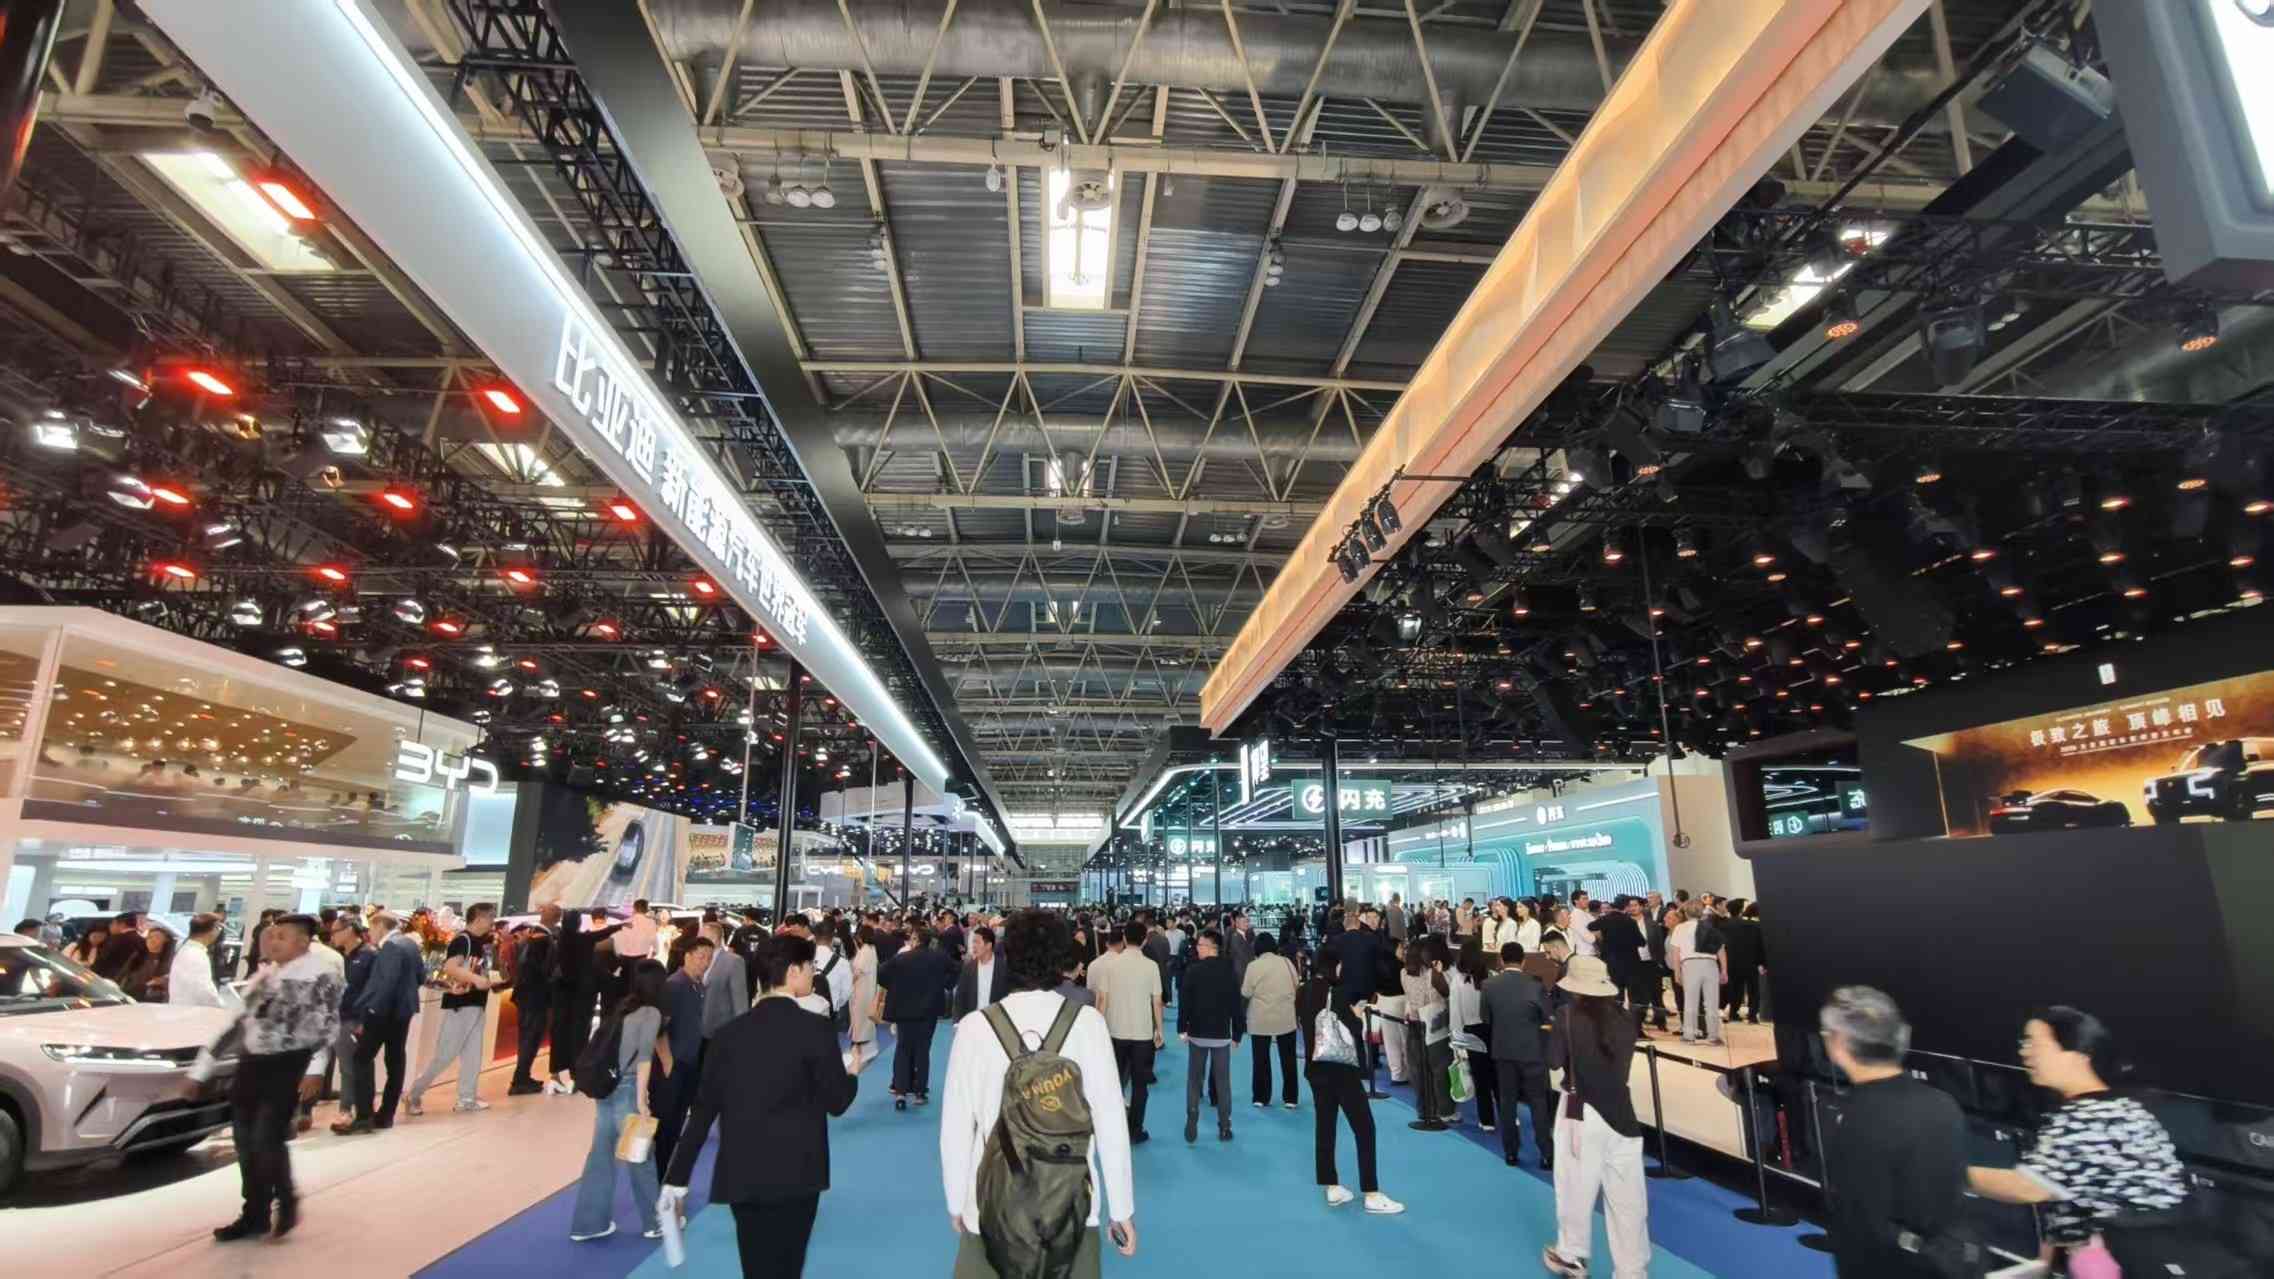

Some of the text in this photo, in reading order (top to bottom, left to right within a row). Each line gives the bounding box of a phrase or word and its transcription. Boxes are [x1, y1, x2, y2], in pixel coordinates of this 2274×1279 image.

[553, 308, 657, 486] 比亚迪
[395, 740, 498, 794] BYD
[1340, 788, 1387, 810] 闪充
